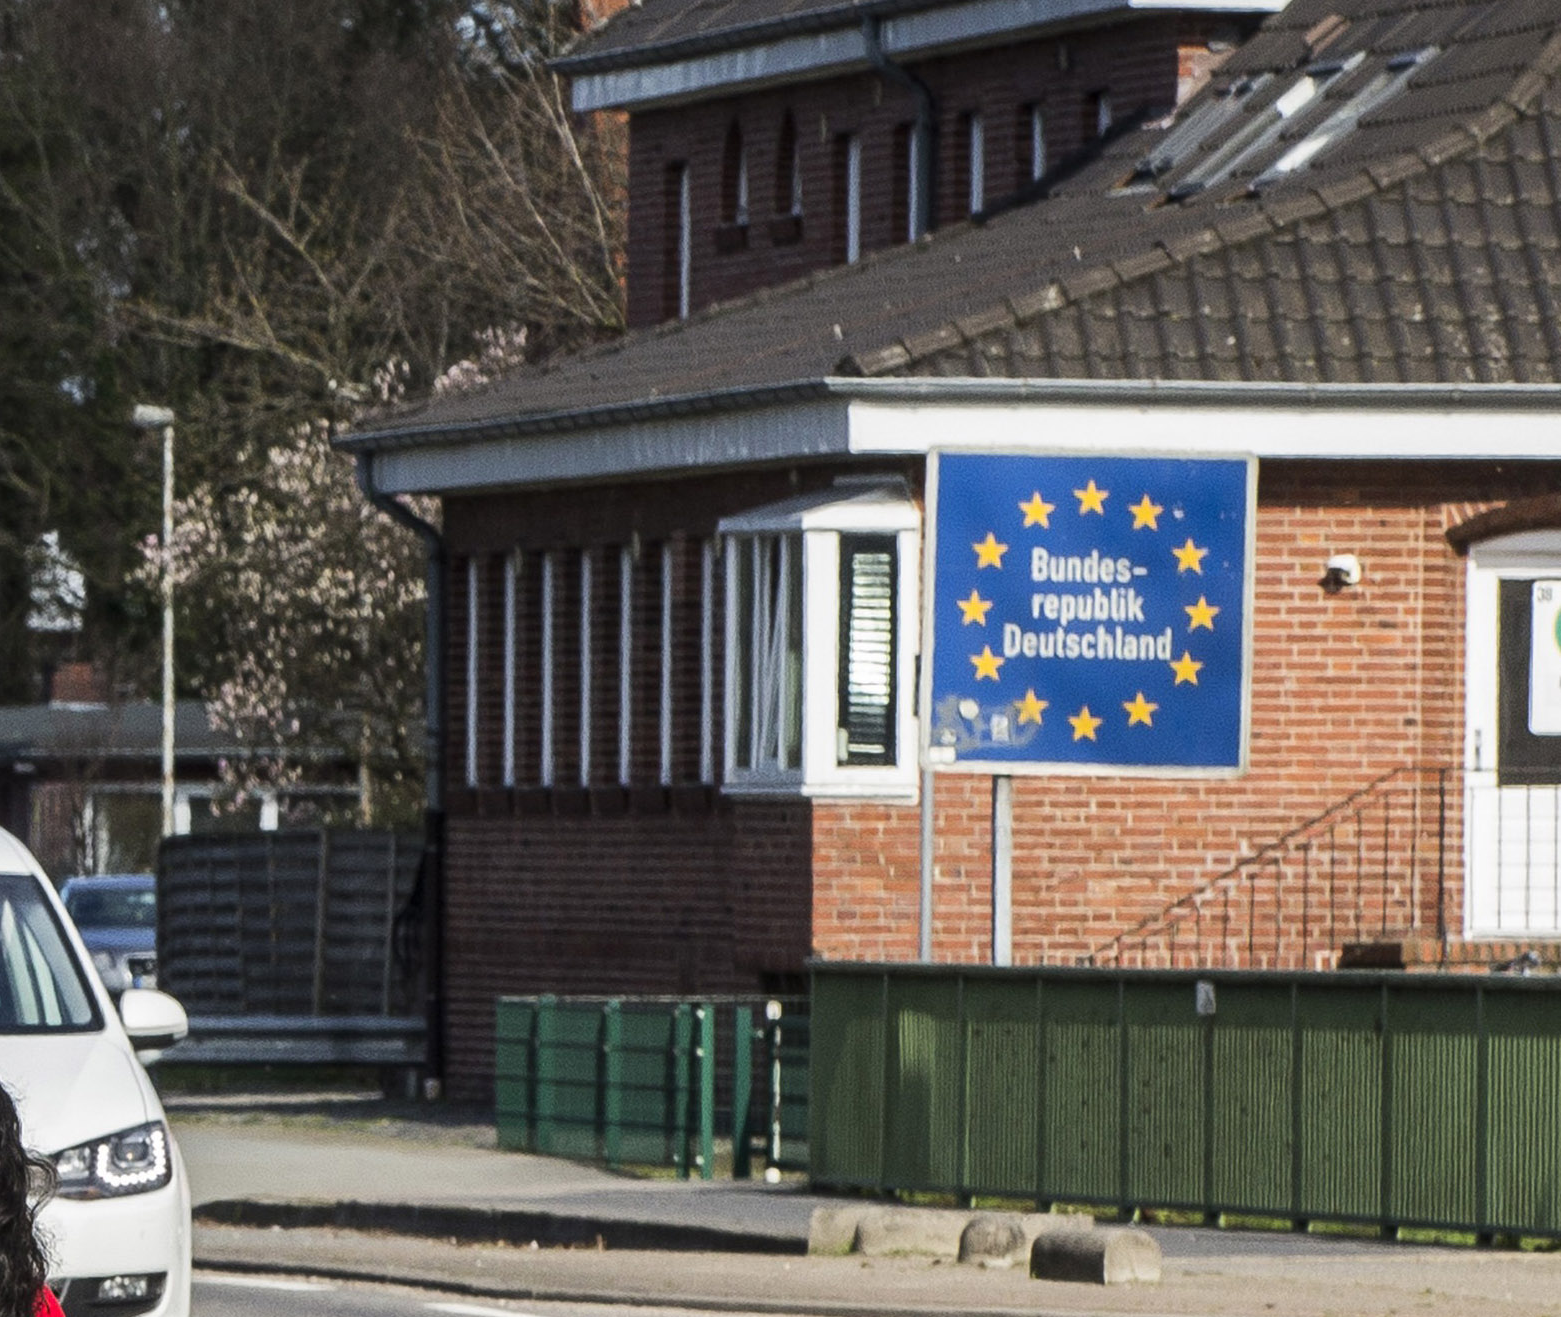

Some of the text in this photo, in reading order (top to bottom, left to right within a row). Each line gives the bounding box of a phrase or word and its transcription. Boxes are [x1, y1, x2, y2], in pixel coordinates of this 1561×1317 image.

[1031, 545, 1148, 584] Bundes-
[1032, 586, 1145, 627] republik
[1003, 622, 1173, 661] Deutschland
